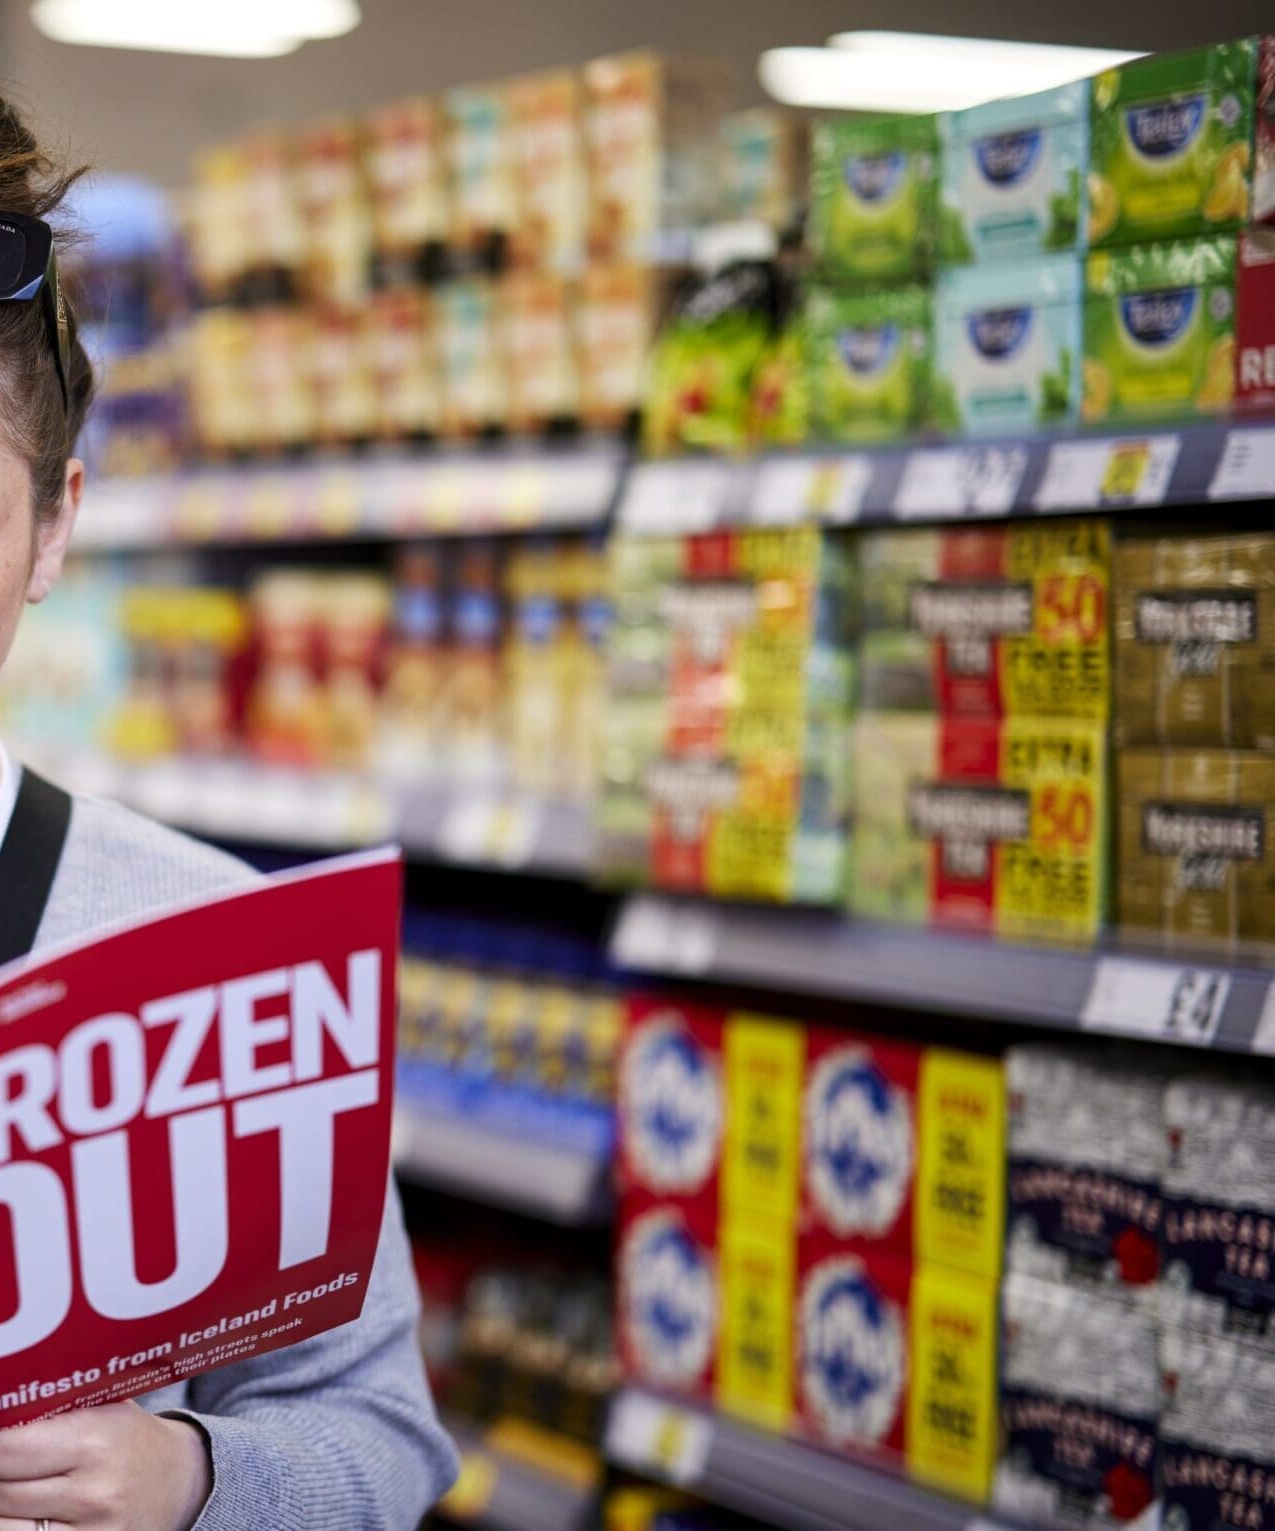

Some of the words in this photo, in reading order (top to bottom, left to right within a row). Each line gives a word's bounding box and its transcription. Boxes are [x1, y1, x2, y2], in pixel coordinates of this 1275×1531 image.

[107, 1340, 172, 1375] from
[179, 1299, 276, 1348] Iceland
[283, 1271, 359, 1310] Foods
[112, 1365, 170, 1391] Britain's
[174, 1350, 203, 1370] high
[207, 1333, 258, 1357] streets
[261, 1316, 303, 1340] speak
[106, 1379, 151, 1401] issues
[154, 1372, 171, 1384] on
[174, 1358, 209, 1377] their
[211, 1343, 256, 1366] plates
